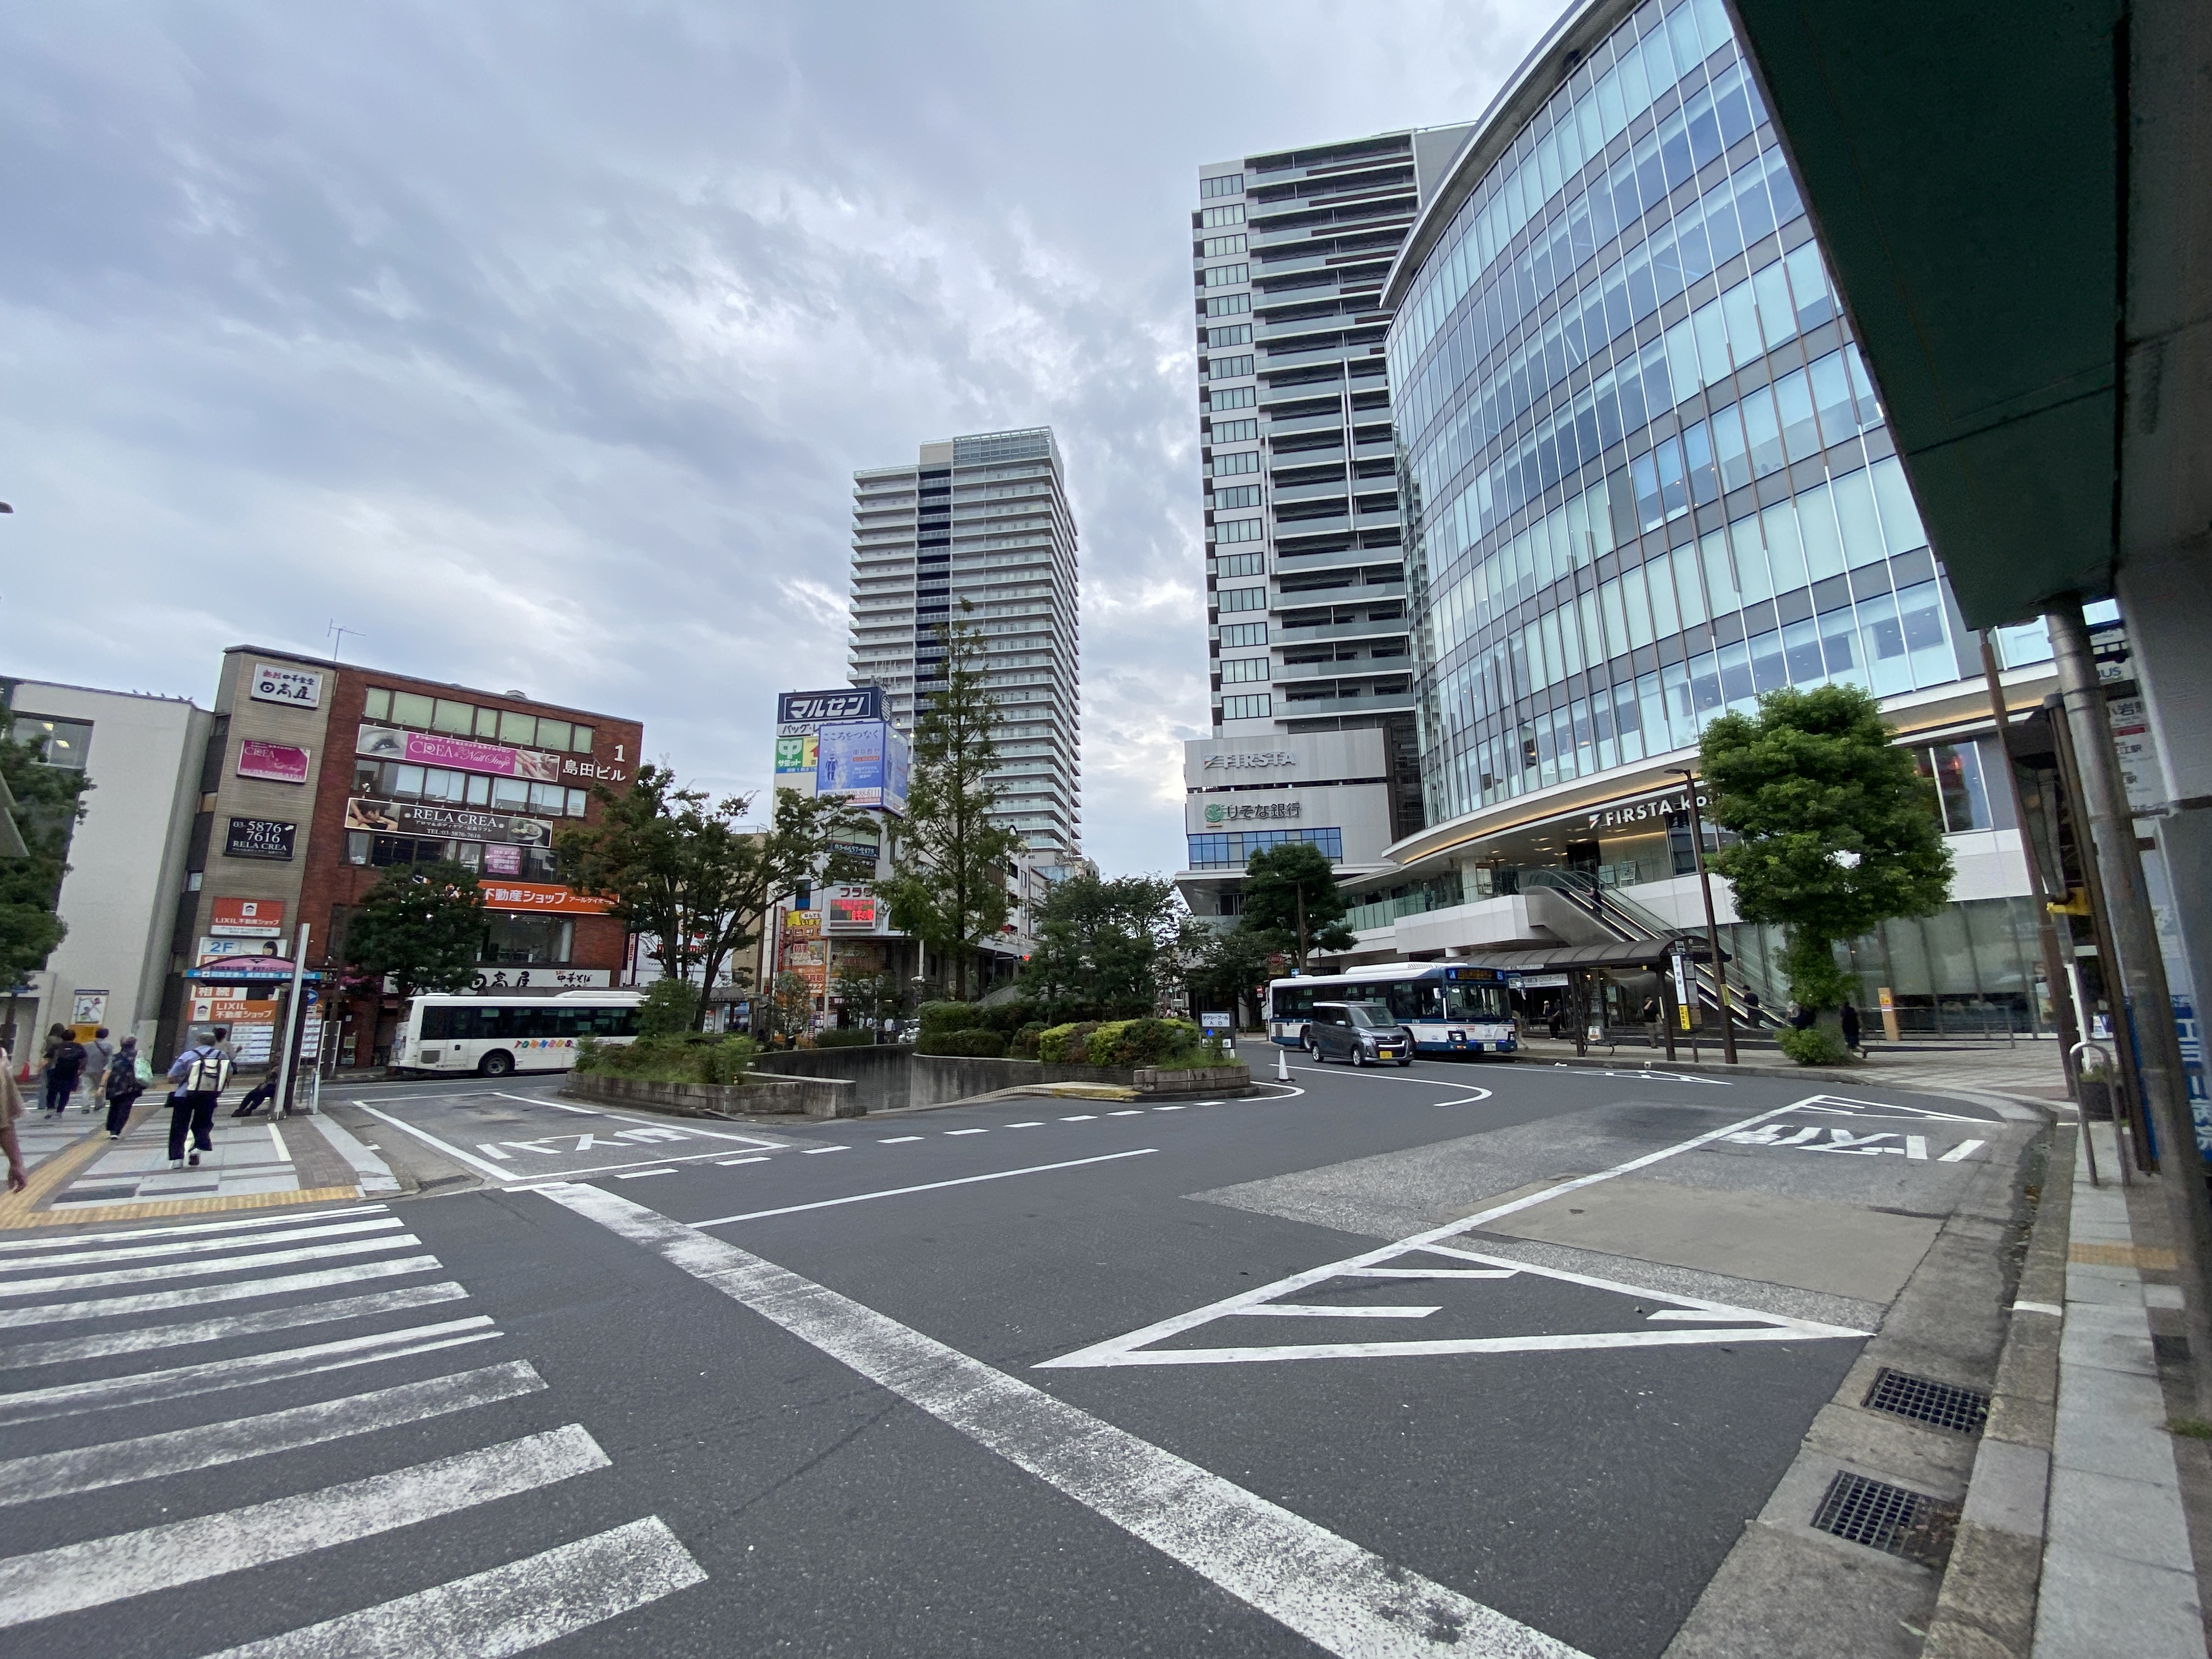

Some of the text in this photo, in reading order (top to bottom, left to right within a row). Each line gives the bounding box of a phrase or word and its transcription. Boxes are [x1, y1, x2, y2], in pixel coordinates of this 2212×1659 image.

[2099, 667, 2121, 678] US
[260, 681, 311, 699] 日高屋
[790, 697, 865, 718] マルゼン
[823, 730, 882, 741] こころをつなぐ
[410, 741, 453, 758] CREA
[614, 744, 625, 763] 1
[1223, 752, 1296, 768] FIRSTA
[563, 759, 627, 782] 島田ビル
[414, 809, 497, 827] RELA CREA
[1227, 803, 1301, 820] りそな銀行
[1606, 799, 1673, 826] FIRSTA
[247, 821, 281, 833] 5876
[247, 831, 280, 843] 7616
[233, 840, 259, 849] RELA
[261, 843, 287, 851] CREA
[483, 887, 568, 905] 不動産ショップ
[210, 941, 234, 952] 2F
[557, 971, 593, 983] 中華そば
[198, 988, 230, 997] 相続
[216, 1010, 273, 1019] 不動産ショップ
